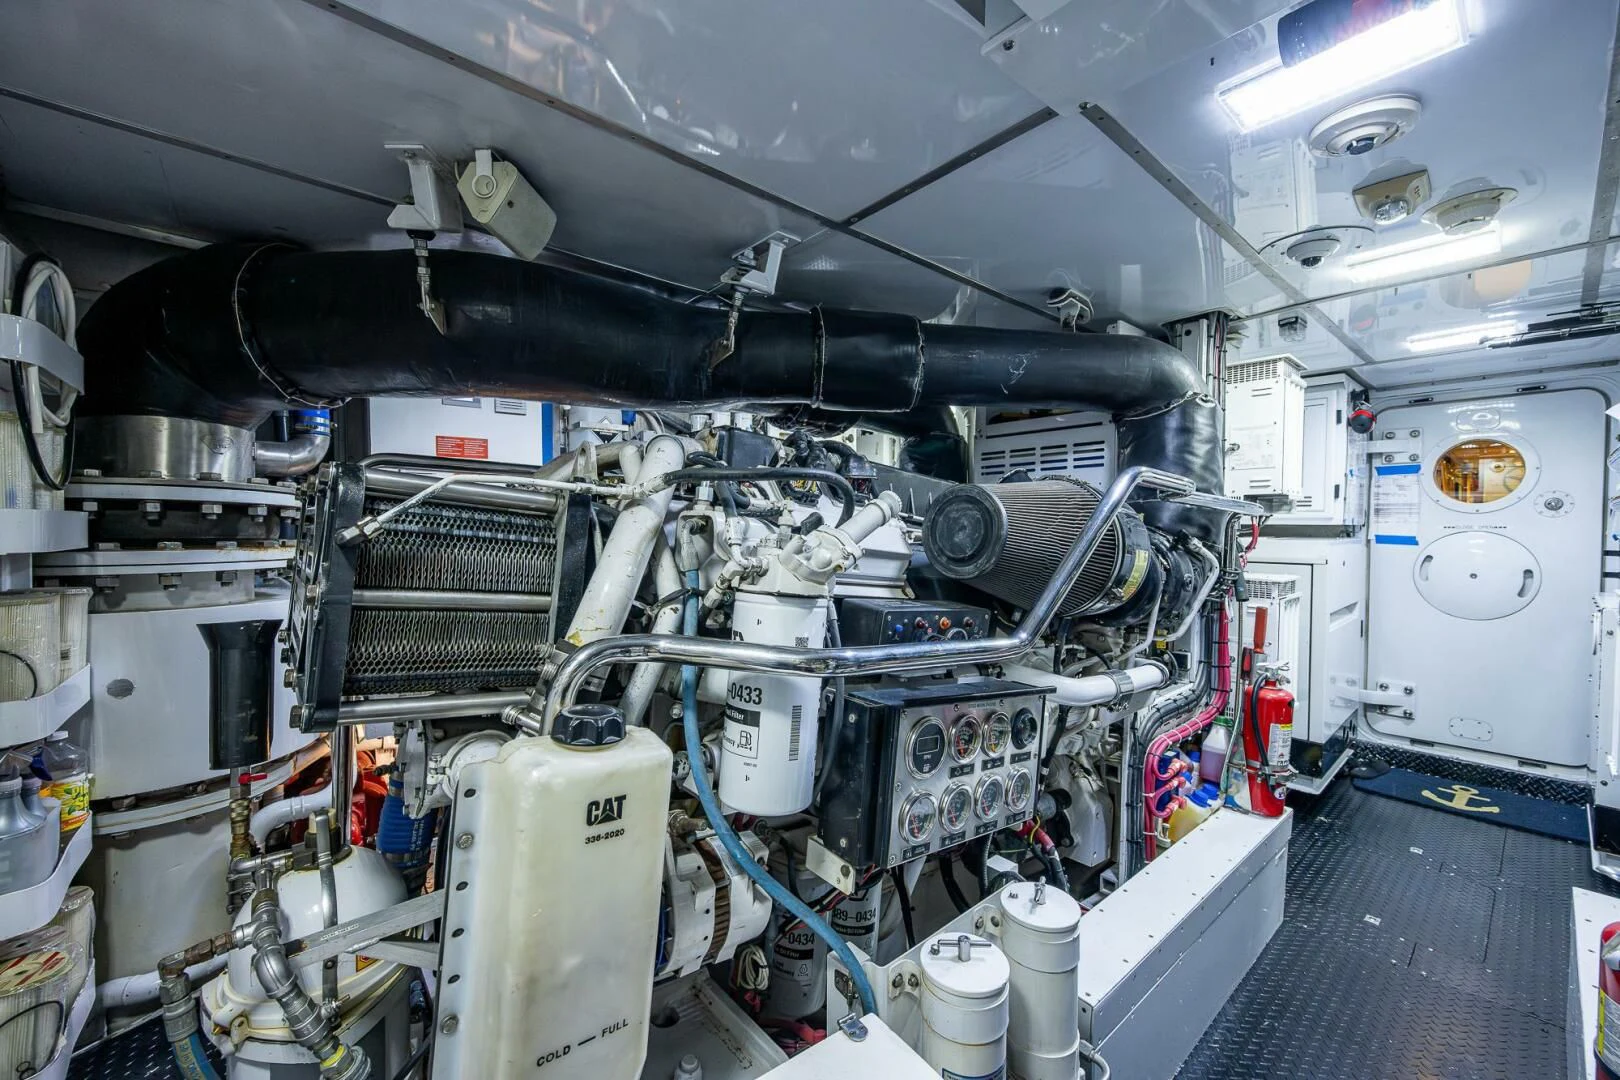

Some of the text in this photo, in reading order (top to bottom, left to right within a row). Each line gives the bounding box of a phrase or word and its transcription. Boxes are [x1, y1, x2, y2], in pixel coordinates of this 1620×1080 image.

[731, 710, 745, 720] Filter
[586, 794, 627, 827] CAT
[584, 828, 625, 845] 336-2020
[536, 1018, 629, 1068] COLD FULL
